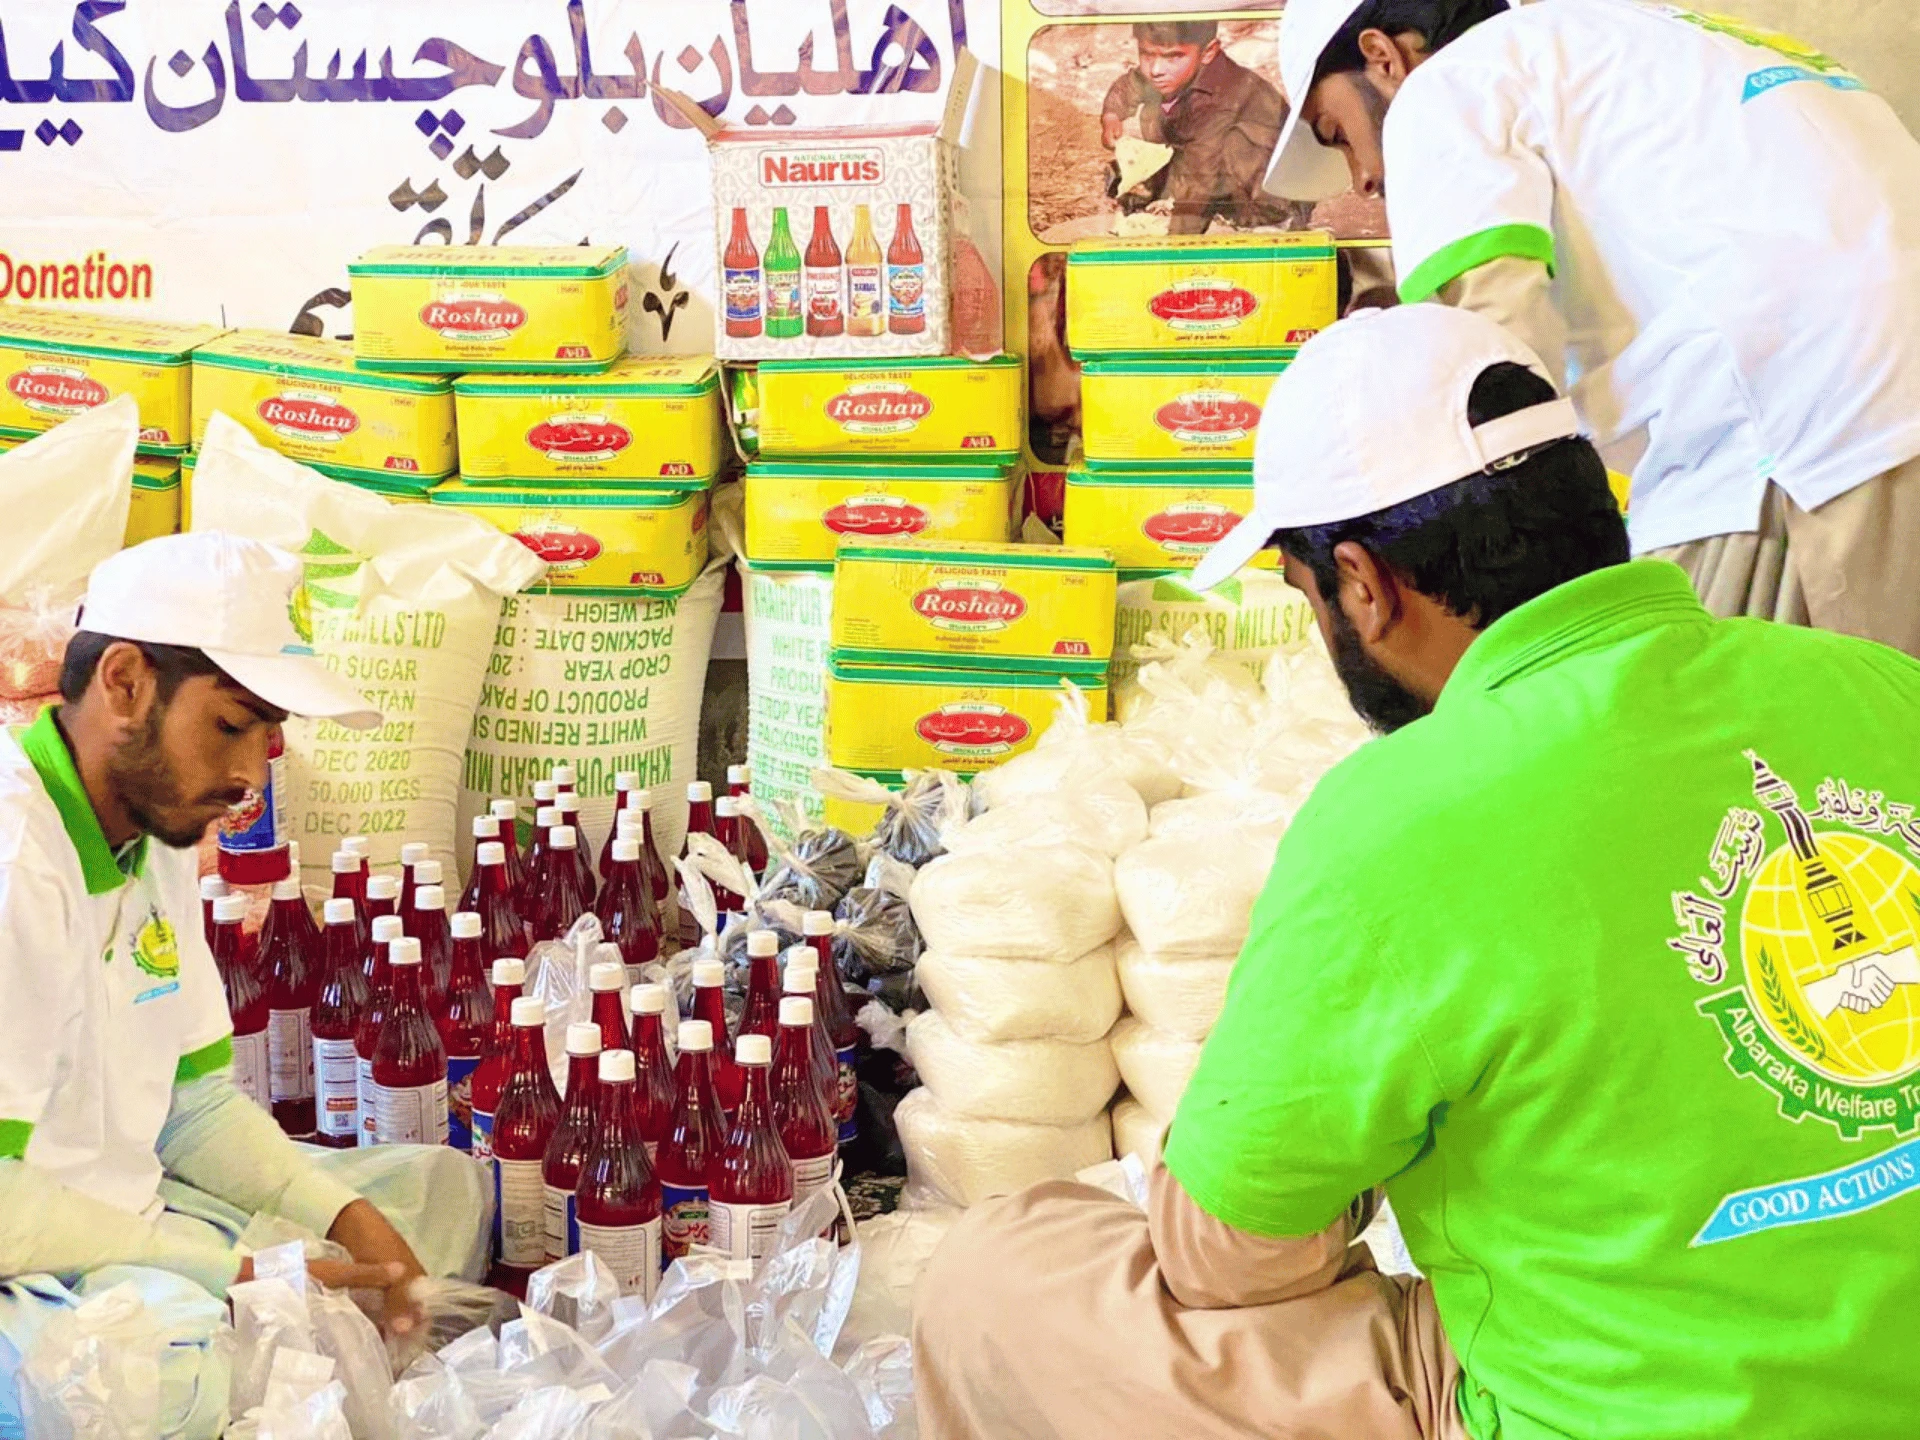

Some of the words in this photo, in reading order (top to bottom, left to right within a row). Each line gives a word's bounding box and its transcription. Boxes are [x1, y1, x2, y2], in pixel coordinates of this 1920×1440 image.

[764, 156, 881, 183] Naurus
[428, 307, 520, 326] Roshan
[15, 377, 100, 403] Roshan
[265, 402, 352, 430] Roshan
[833, 398, 925, 417] Roshan
[563, 602, 638, 624] WEIGHT
[642, 599, 678, 622] NET
[919, 593, 1018, 616] Roshan
[591, 625, 674, 653] PACKING
[1235, 602, 1293, 651] MILLS
[534, 628, 586, 653] DATE
[772, 634, 816, 663] WHITE
[347, 655, 418, 682] SUGAR
[564, 659, 615, 683] YEAR
[619, 653, 672, 681] CROP
[521, 689, 549, 713] OF
[553, 687, 649, 715] PRODUCT
[494, 718, 581, 747] REFINED
[586, 716, 648, 747] WHITE
[313, 749, 358, 772] DEC
[364, 749, 411, 772] 2020
[380, 777, 421, 801] KGS
[304, 811, 350, 835] DEC
[359, 809, 406, 834] 2022
[1724, 1006, 1809, 1099] Albaraka
[1814, 1083, 1897, 1120] Welfare
[1728, 1188, 1811, 1227] GOOD
[1817, 1152, 1916, 1211] ACTIONS
